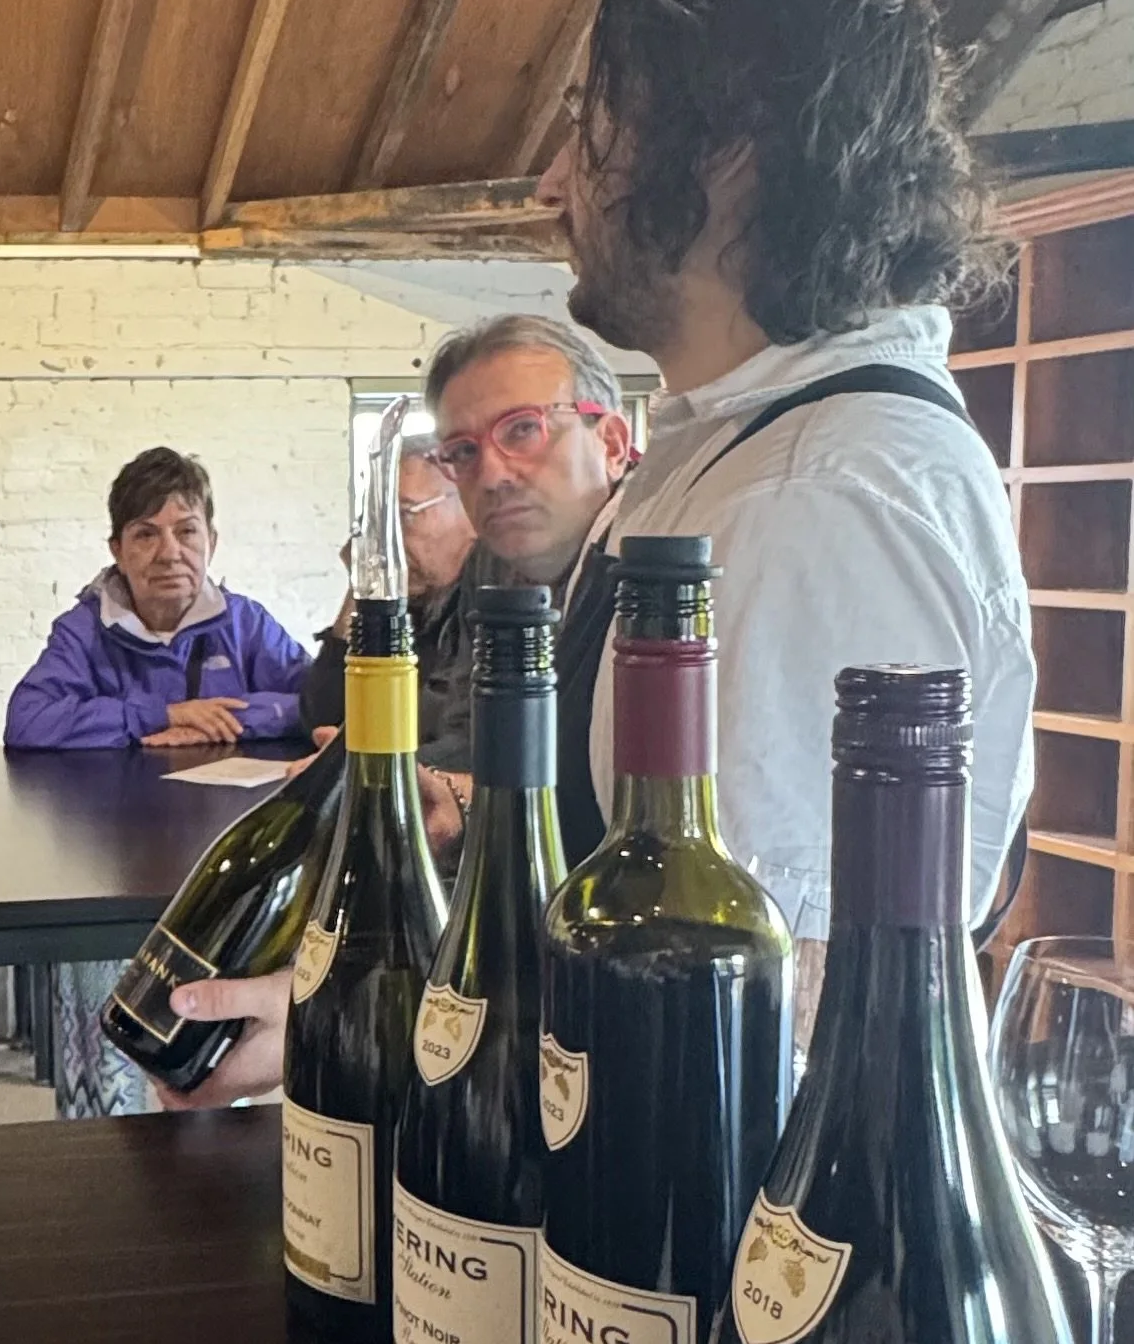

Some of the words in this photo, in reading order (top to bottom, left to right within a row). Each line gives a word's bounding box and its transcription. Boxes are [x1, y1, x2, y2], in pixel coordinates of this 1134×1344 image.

[422, 1039, 450, 1060] 2023
[542, 1095, 564, 1122] 023
[394, 1214, 488, 1281] ERING
[742, 1280, 783, 1320] 2018
